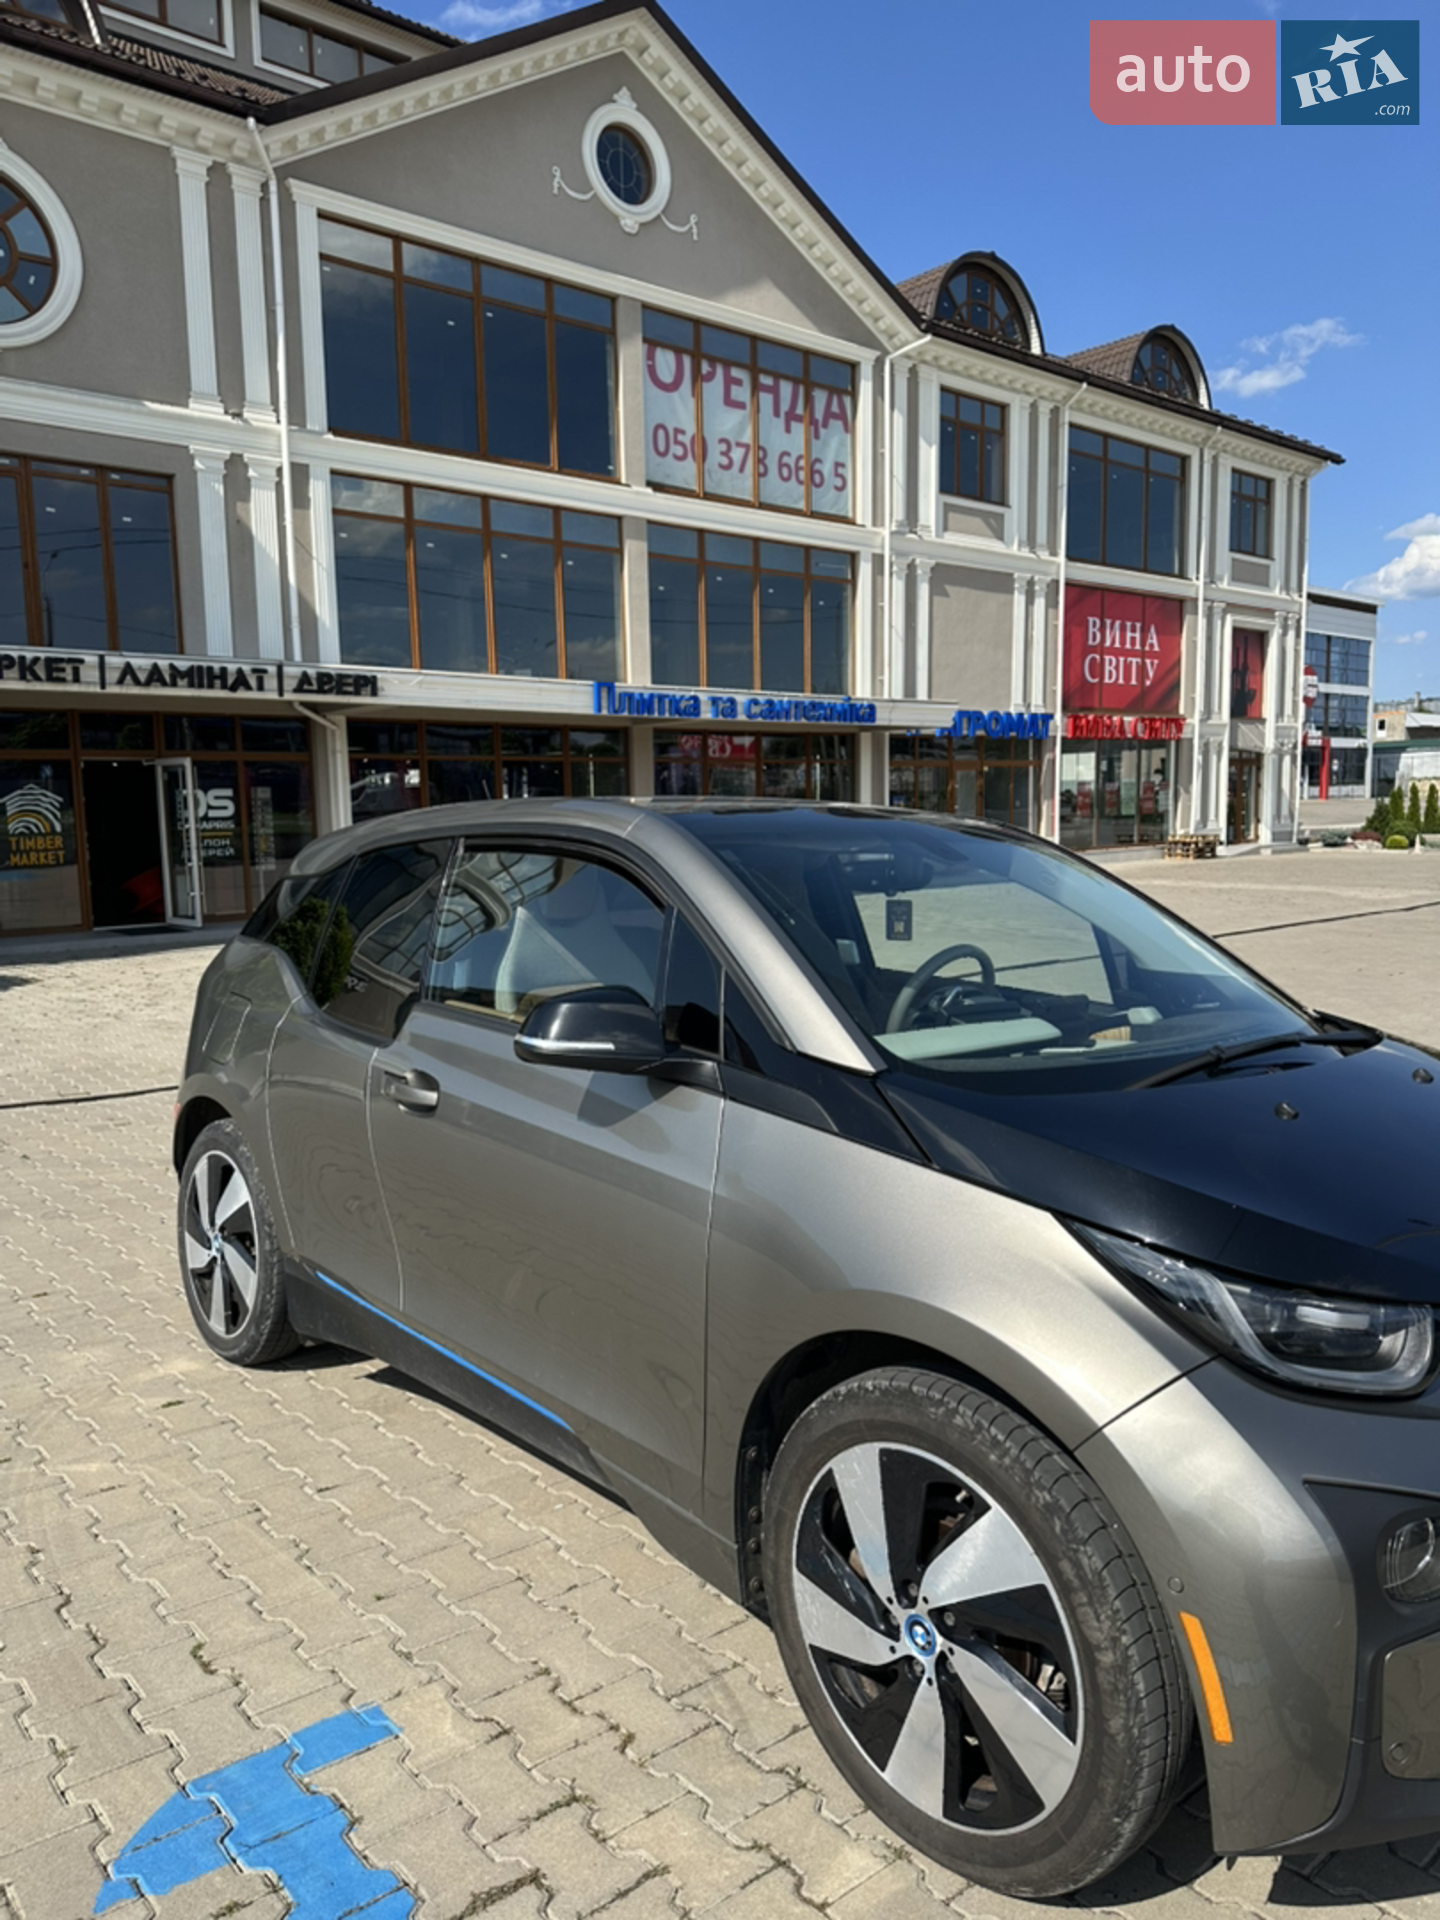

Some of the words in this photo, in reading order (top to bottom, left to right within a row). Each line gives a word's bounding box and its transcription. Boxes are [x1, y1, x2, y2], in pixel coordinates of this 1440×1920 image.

[646, 345, 850, 439] ОРЕНДА
[652, 423, 708, 464] 050
[1087, 616, 1160, 652] ВИНА
[116, 661, 269, 693] ЛАМІНАТ
[293, 669, 379, 697] ДВЕРІ
[1084, 653, 1160, 687] СВІТУ
[593, 681, 701, 719] Плитка
[708, 696, 738, 720] та
[744, 695, 877, 724] сантехніка
[8, 836, 64, 851] TIMBER
[10, 850, 65, 867] MARKET
